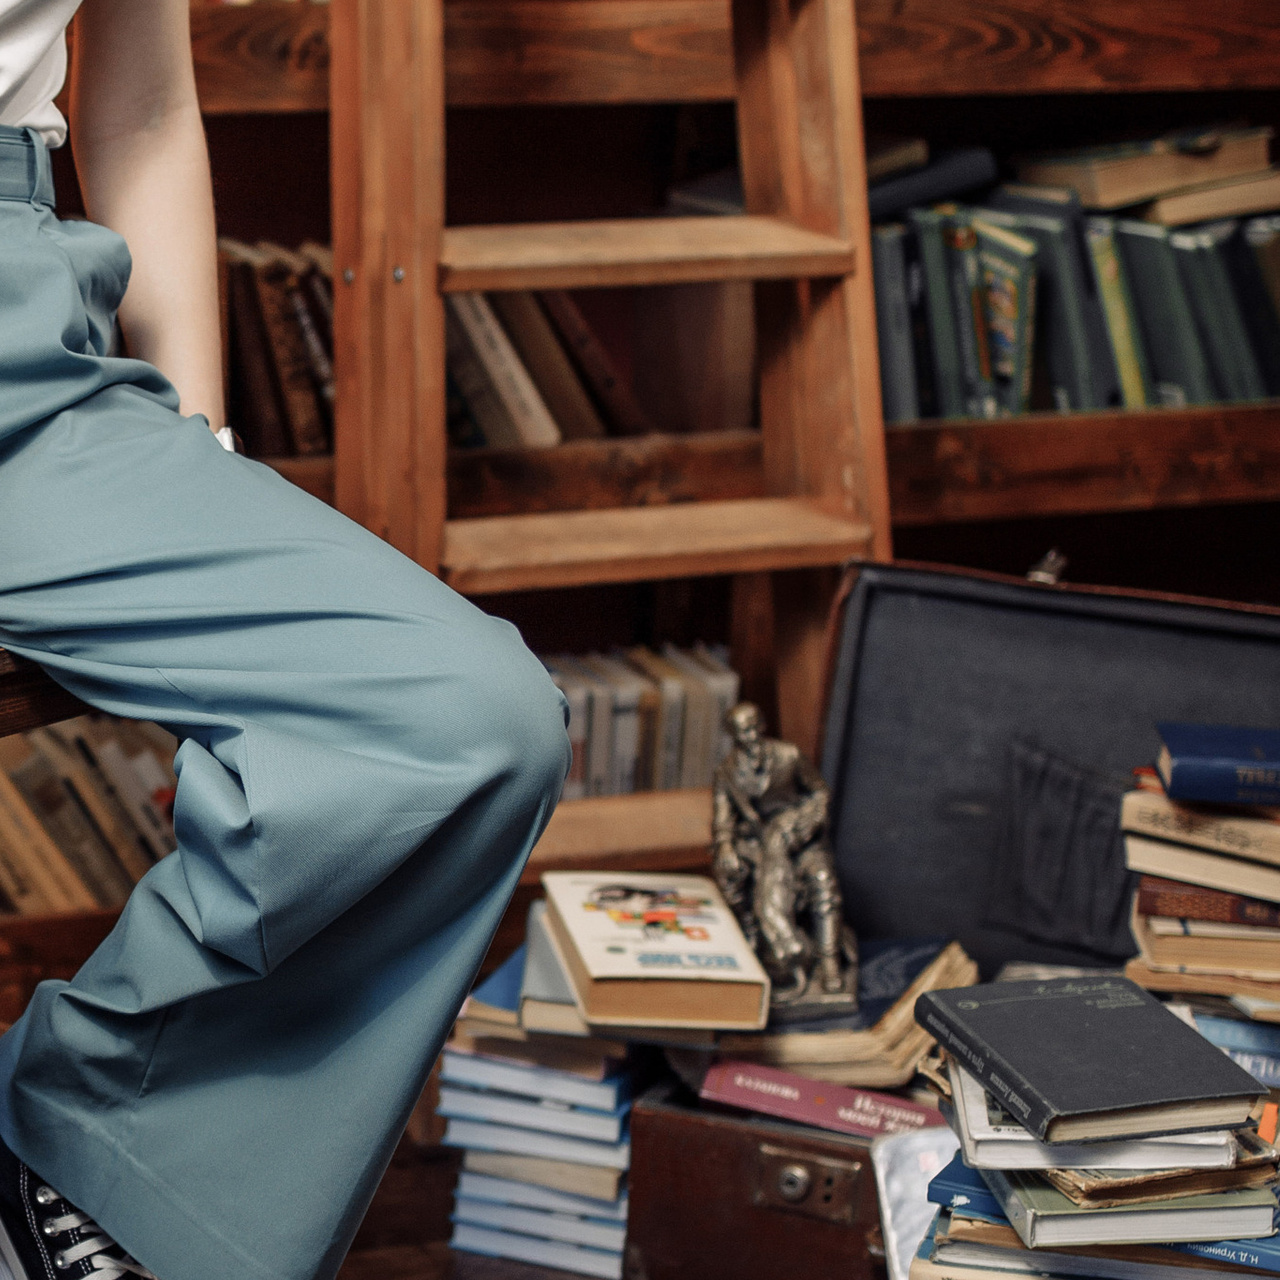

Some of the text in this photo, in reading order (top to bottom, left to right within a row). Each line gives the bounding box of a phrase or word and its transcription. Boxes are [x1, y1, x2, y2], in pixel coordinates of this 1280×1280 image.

[1185, 1240, 1259, 1264] Н. Д. Угринович
